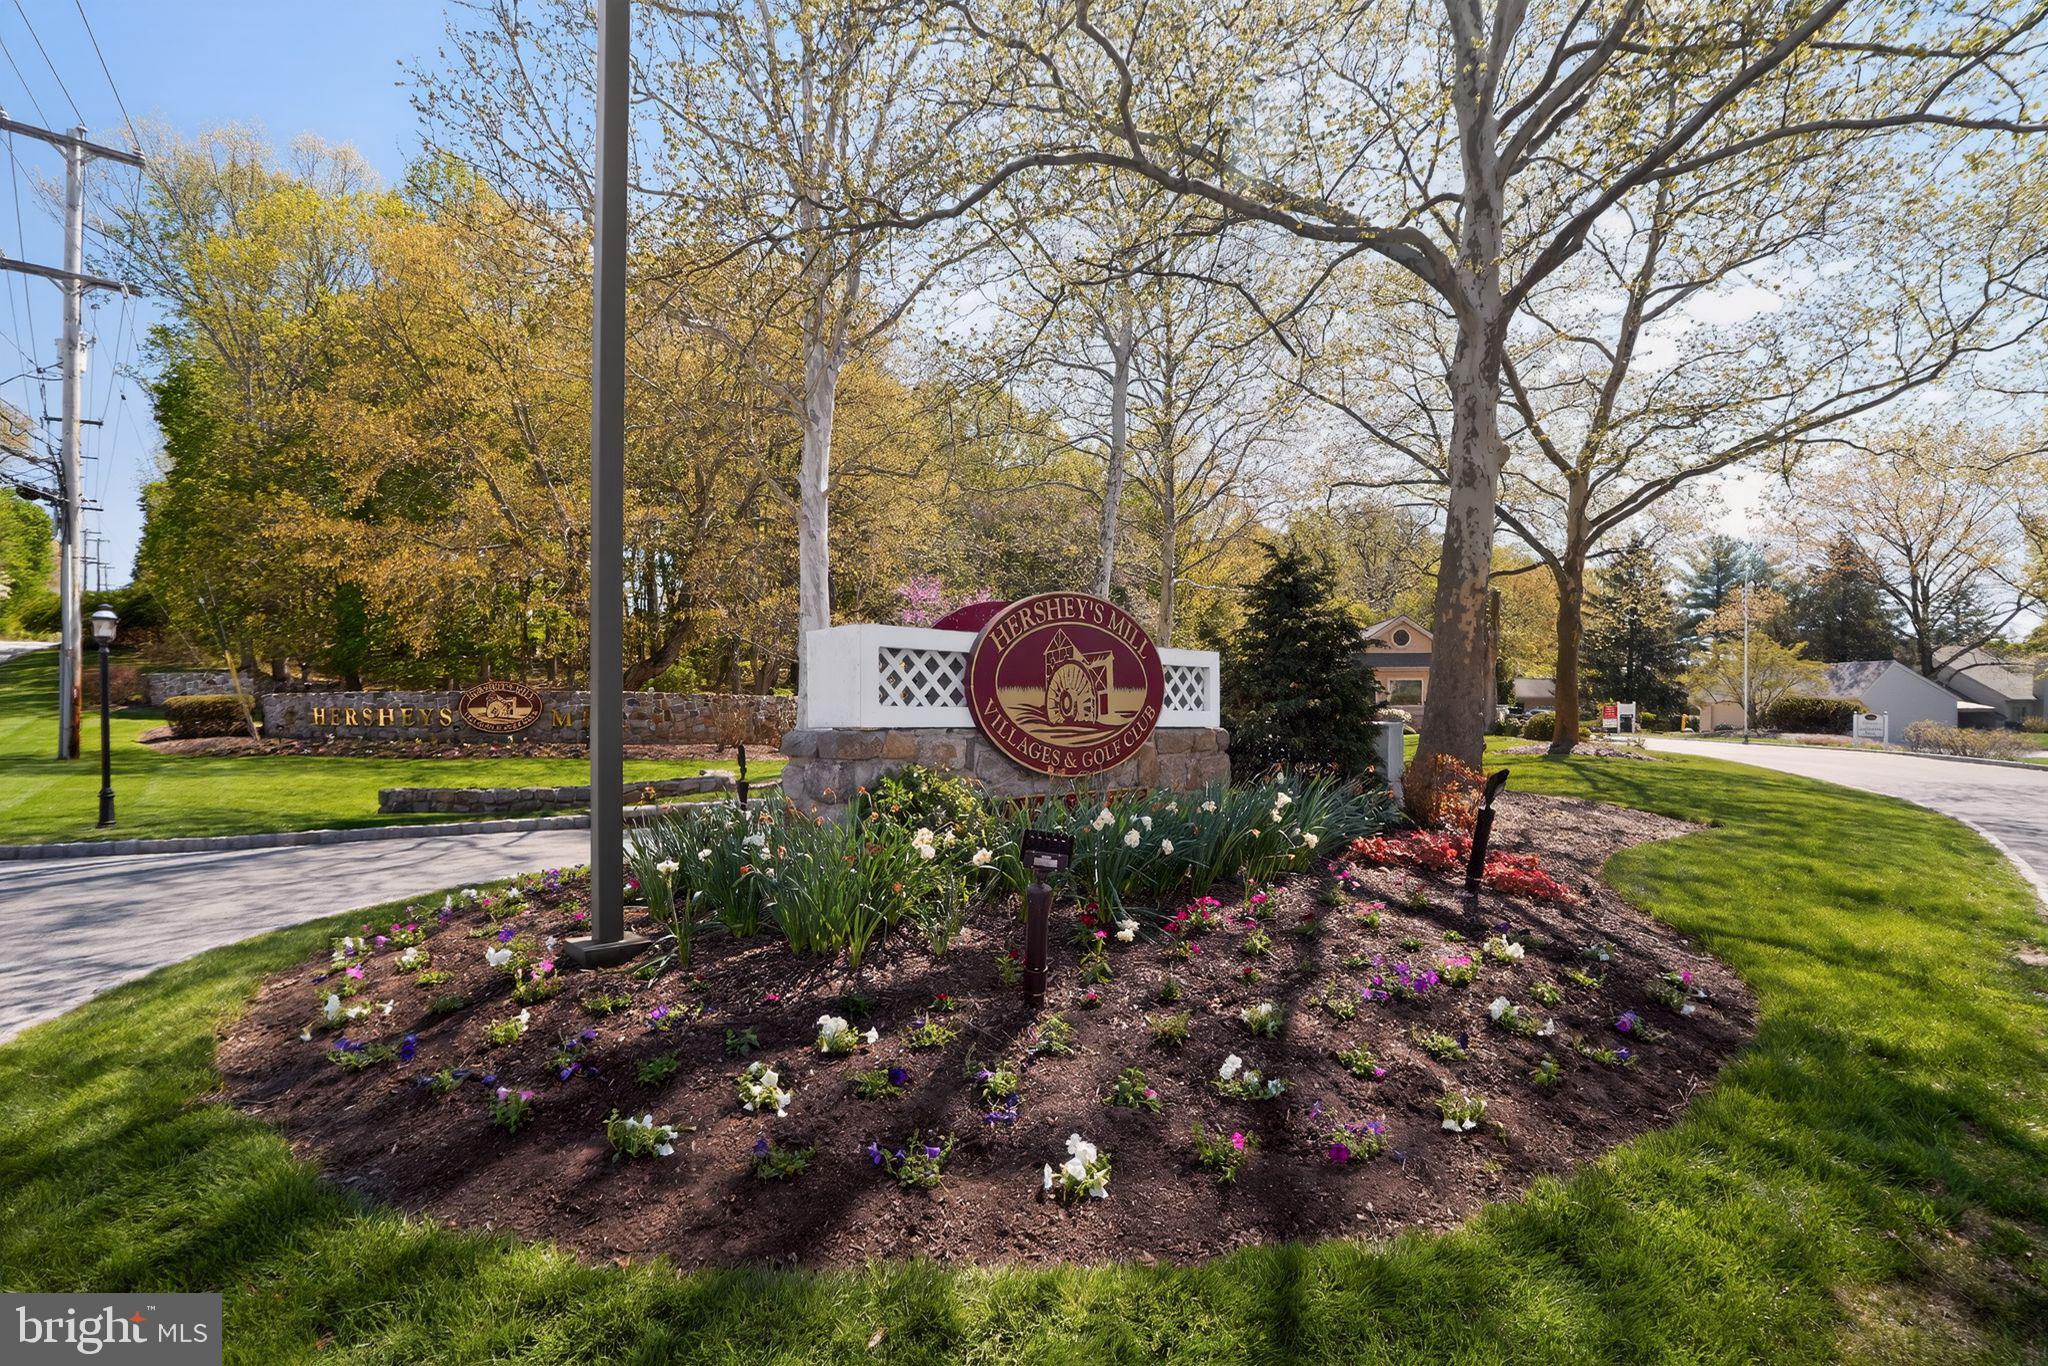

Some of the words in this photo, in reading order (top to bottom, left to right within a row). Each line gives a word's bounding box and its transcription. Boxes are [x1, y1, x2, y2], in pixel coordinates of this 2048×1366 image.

[988, 596, 1105, 653] HERSHEY'S
[1107, 611, 1149, 660] MILL
[312, 706, 453, 727] HERSHEYS
[983, 698, 1061, 768] VILLAGES
[1064, 752, 1078, 769] &
[1082, 741, 1122, 768] GOLF
[1123, 705, 1157, 749] CLUB
